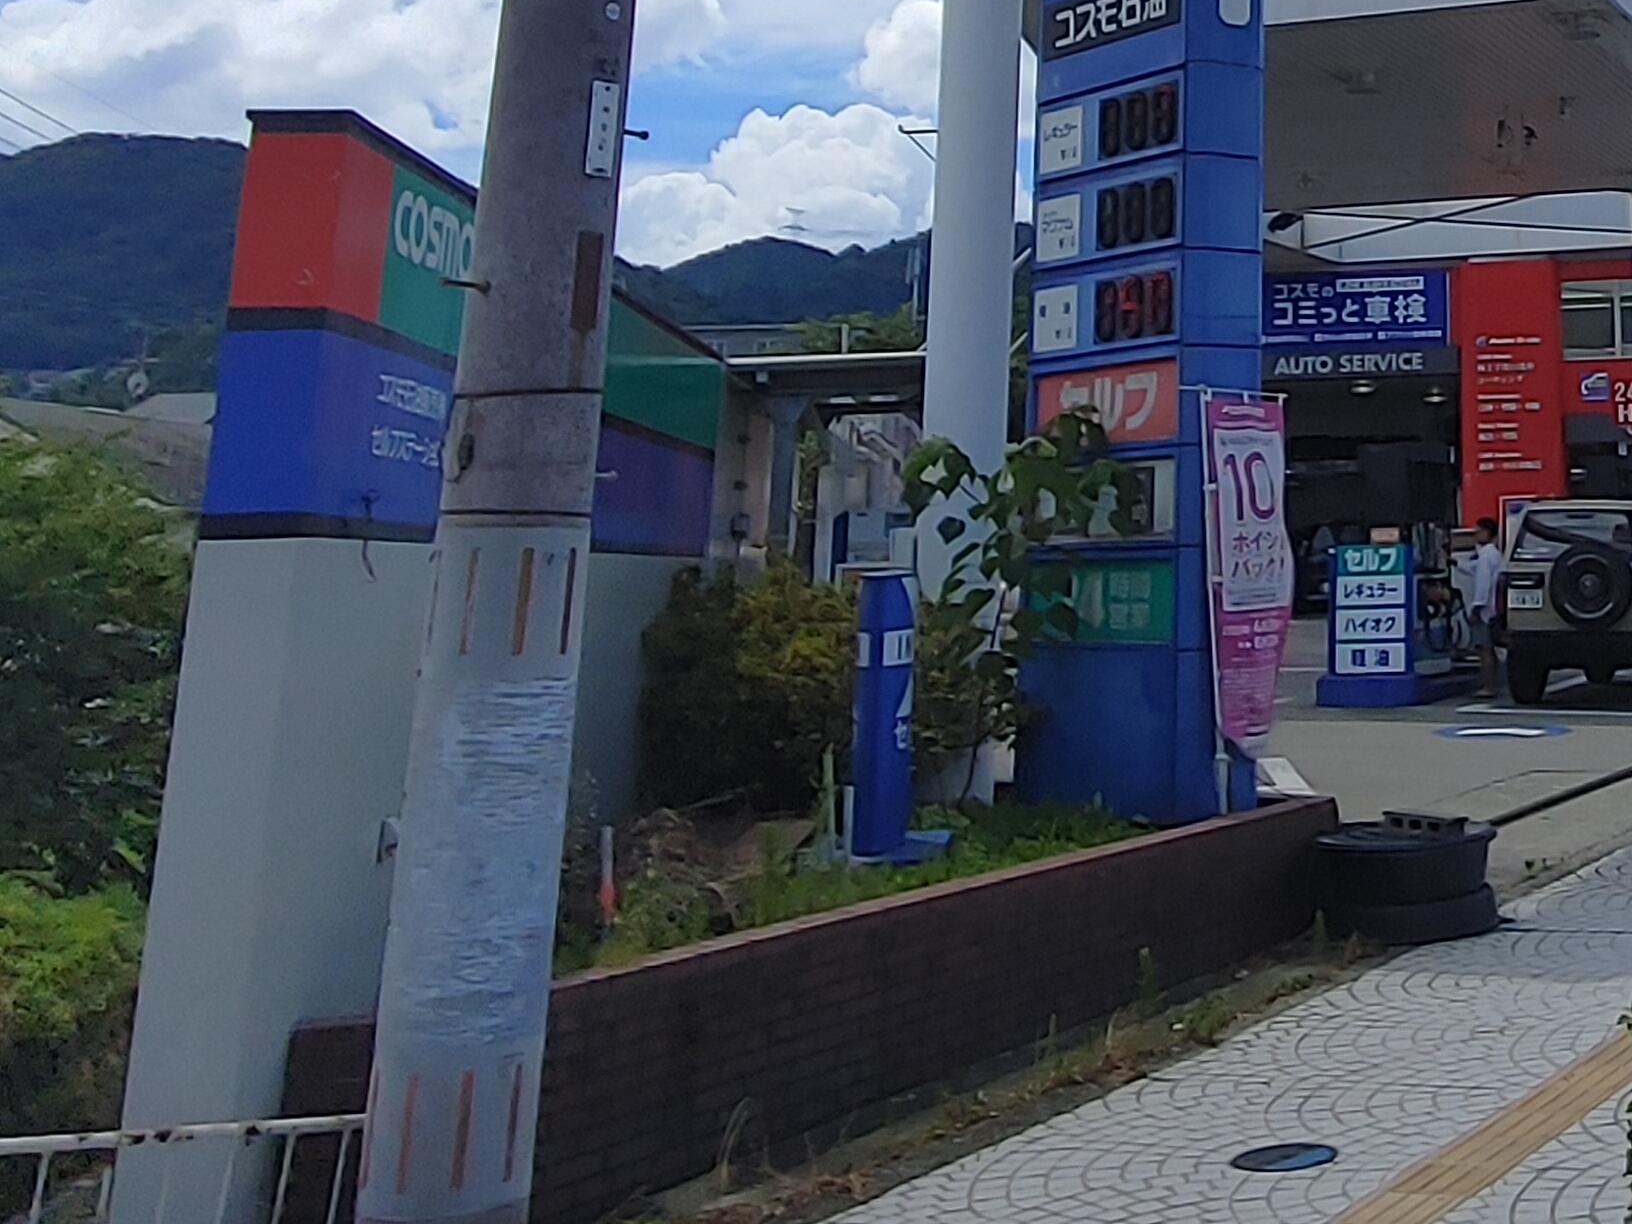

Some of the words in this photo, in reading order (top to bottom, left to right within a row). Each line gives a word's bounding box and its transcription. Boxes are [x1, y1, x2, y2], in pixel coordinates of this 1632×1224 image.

[394, 190, 476, 280] COSMO
[1273, 294, 1427, 325] コミっと車検
[1274, 356, 1333, 375] AUTO
[1339, 352, 1425, 373] SERVICE
[1223, 449, 1275, 521] 10
[1345, 549, 1397, 572] セルフ
[1344, 583, 1398, 599] レギュラー
[1345, 617, 1396, 632] ハイオク
